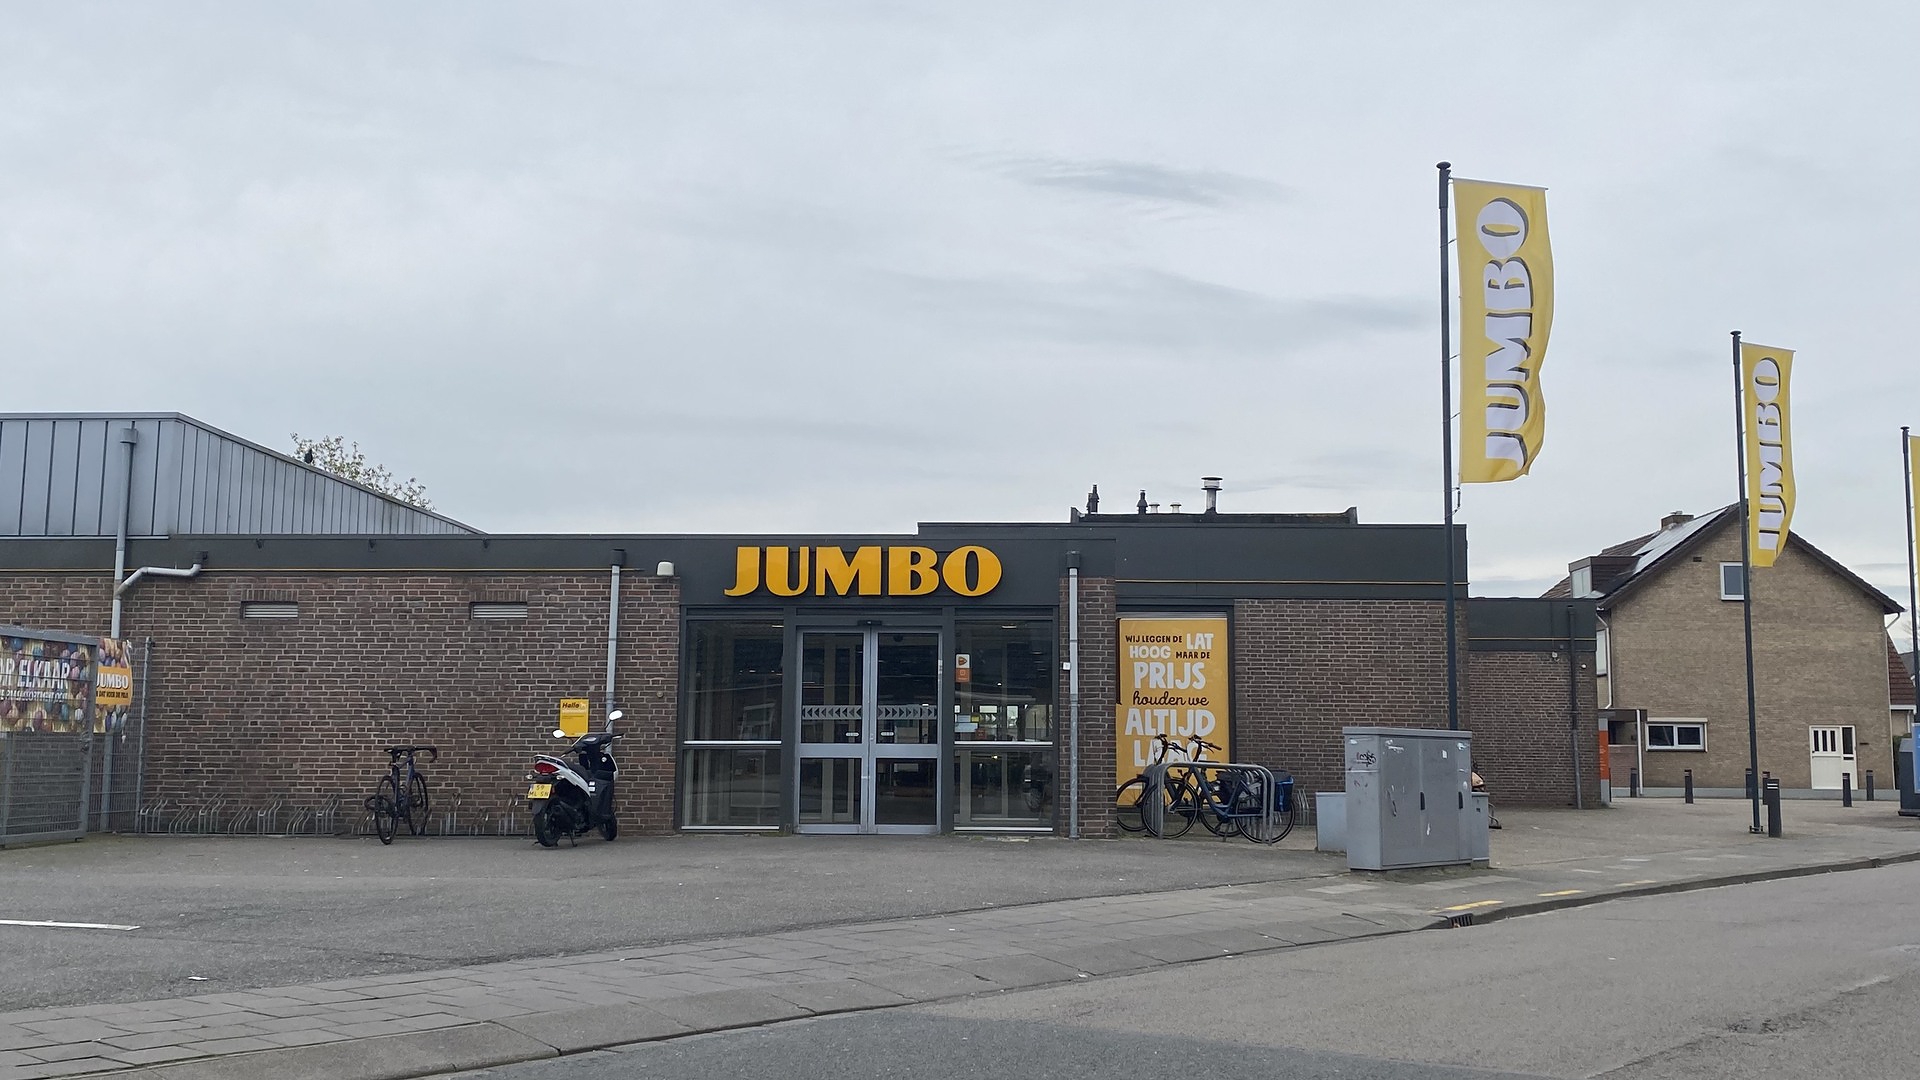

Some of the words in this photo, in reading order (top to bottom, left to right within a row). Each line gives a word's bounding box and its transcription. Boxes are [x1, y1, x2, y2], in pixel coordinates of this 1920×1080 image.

[1476, 197, 1533, 471] JUMBO
[1752, 357, 1787, 557] JUMBO
[723, 544, 1003, 597] JUMBO
[1125, 635, 1141, 643] WIJ
[1142, 635, 1171, 643] LEGGEN
[1173, 635, 1182, 643] DE
[1186, 633, 1214, 650] LAT
[1129, 645, 1171, 659] HOOG
[1175, 651, 1199, 659] MAAR
[1200, 651, 1210, 659] DE
[17, 659, 70, 690] ELKAAR
[96, 672, 129, 690] JUMBO
[1133, 661, 1207, 690] PRIJS
[1133, 691, 1187, 706] houden
[1188, 697, 1209, 706] we
[1125, 708, 1216, 737] ALTIJD
